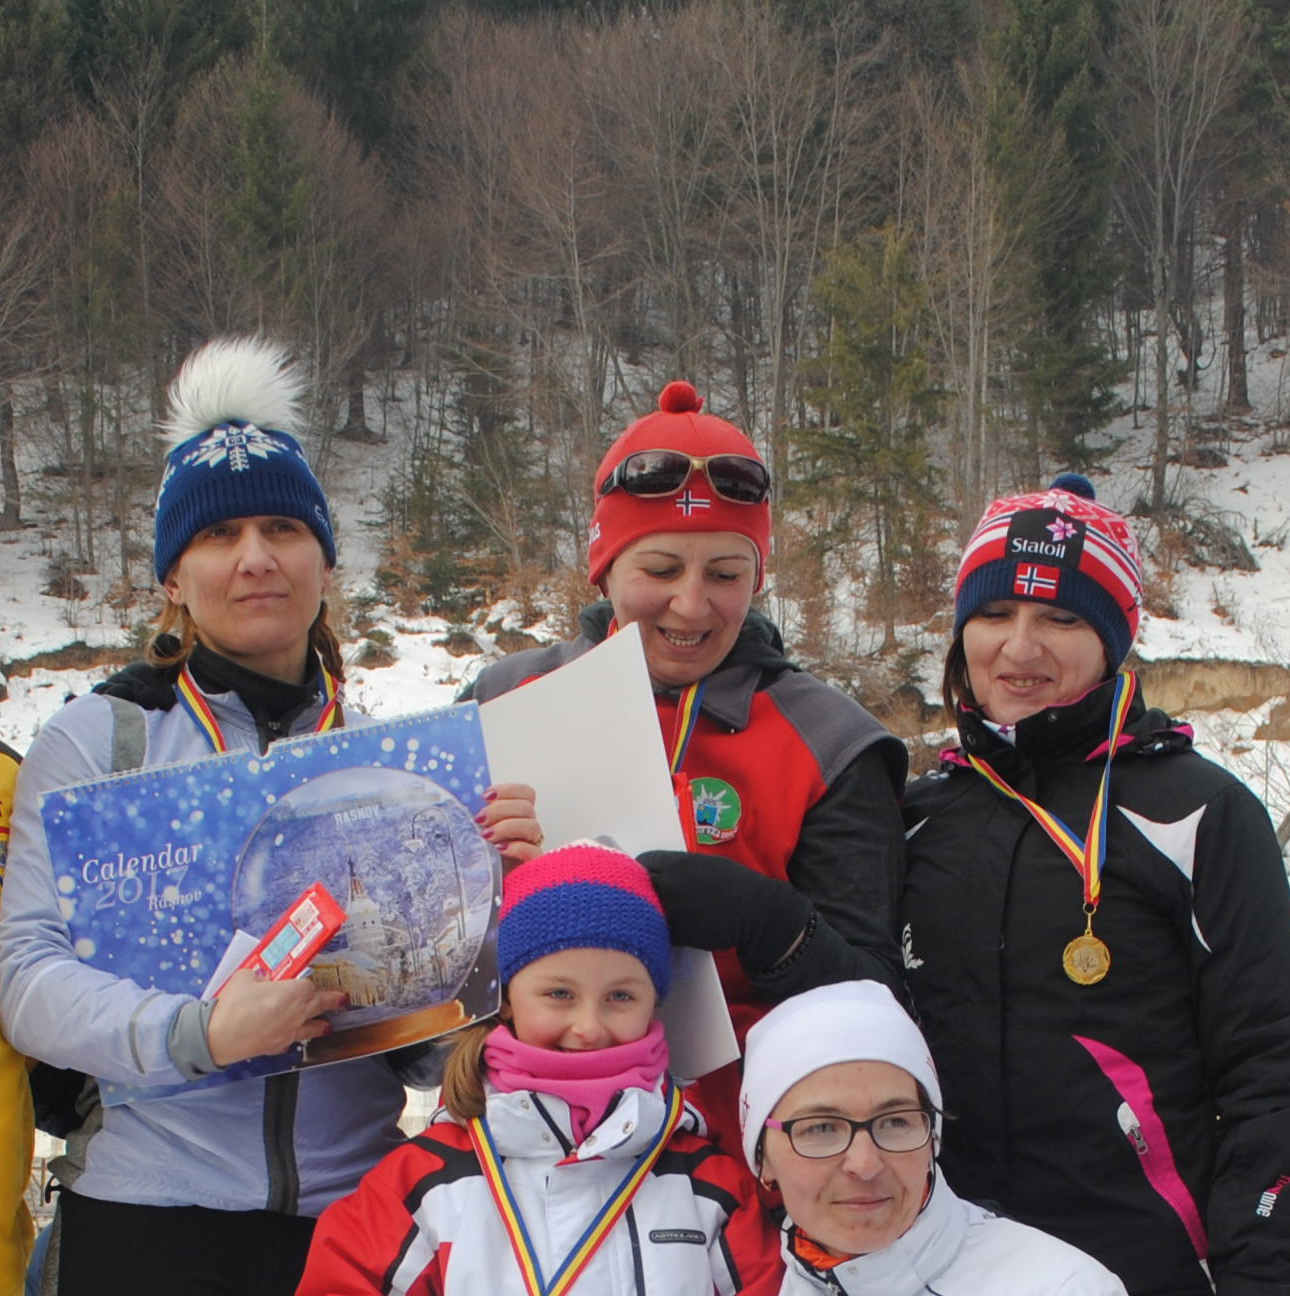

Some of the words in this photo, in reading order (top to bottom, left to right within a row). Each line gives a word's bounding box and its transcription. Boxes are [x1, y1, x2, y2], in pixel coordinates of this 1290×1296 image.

[1011, 537, 1066, 559] Statoil
[82, 842, 204, 884] Calendar
[95, 865, 189, 911] 2017
